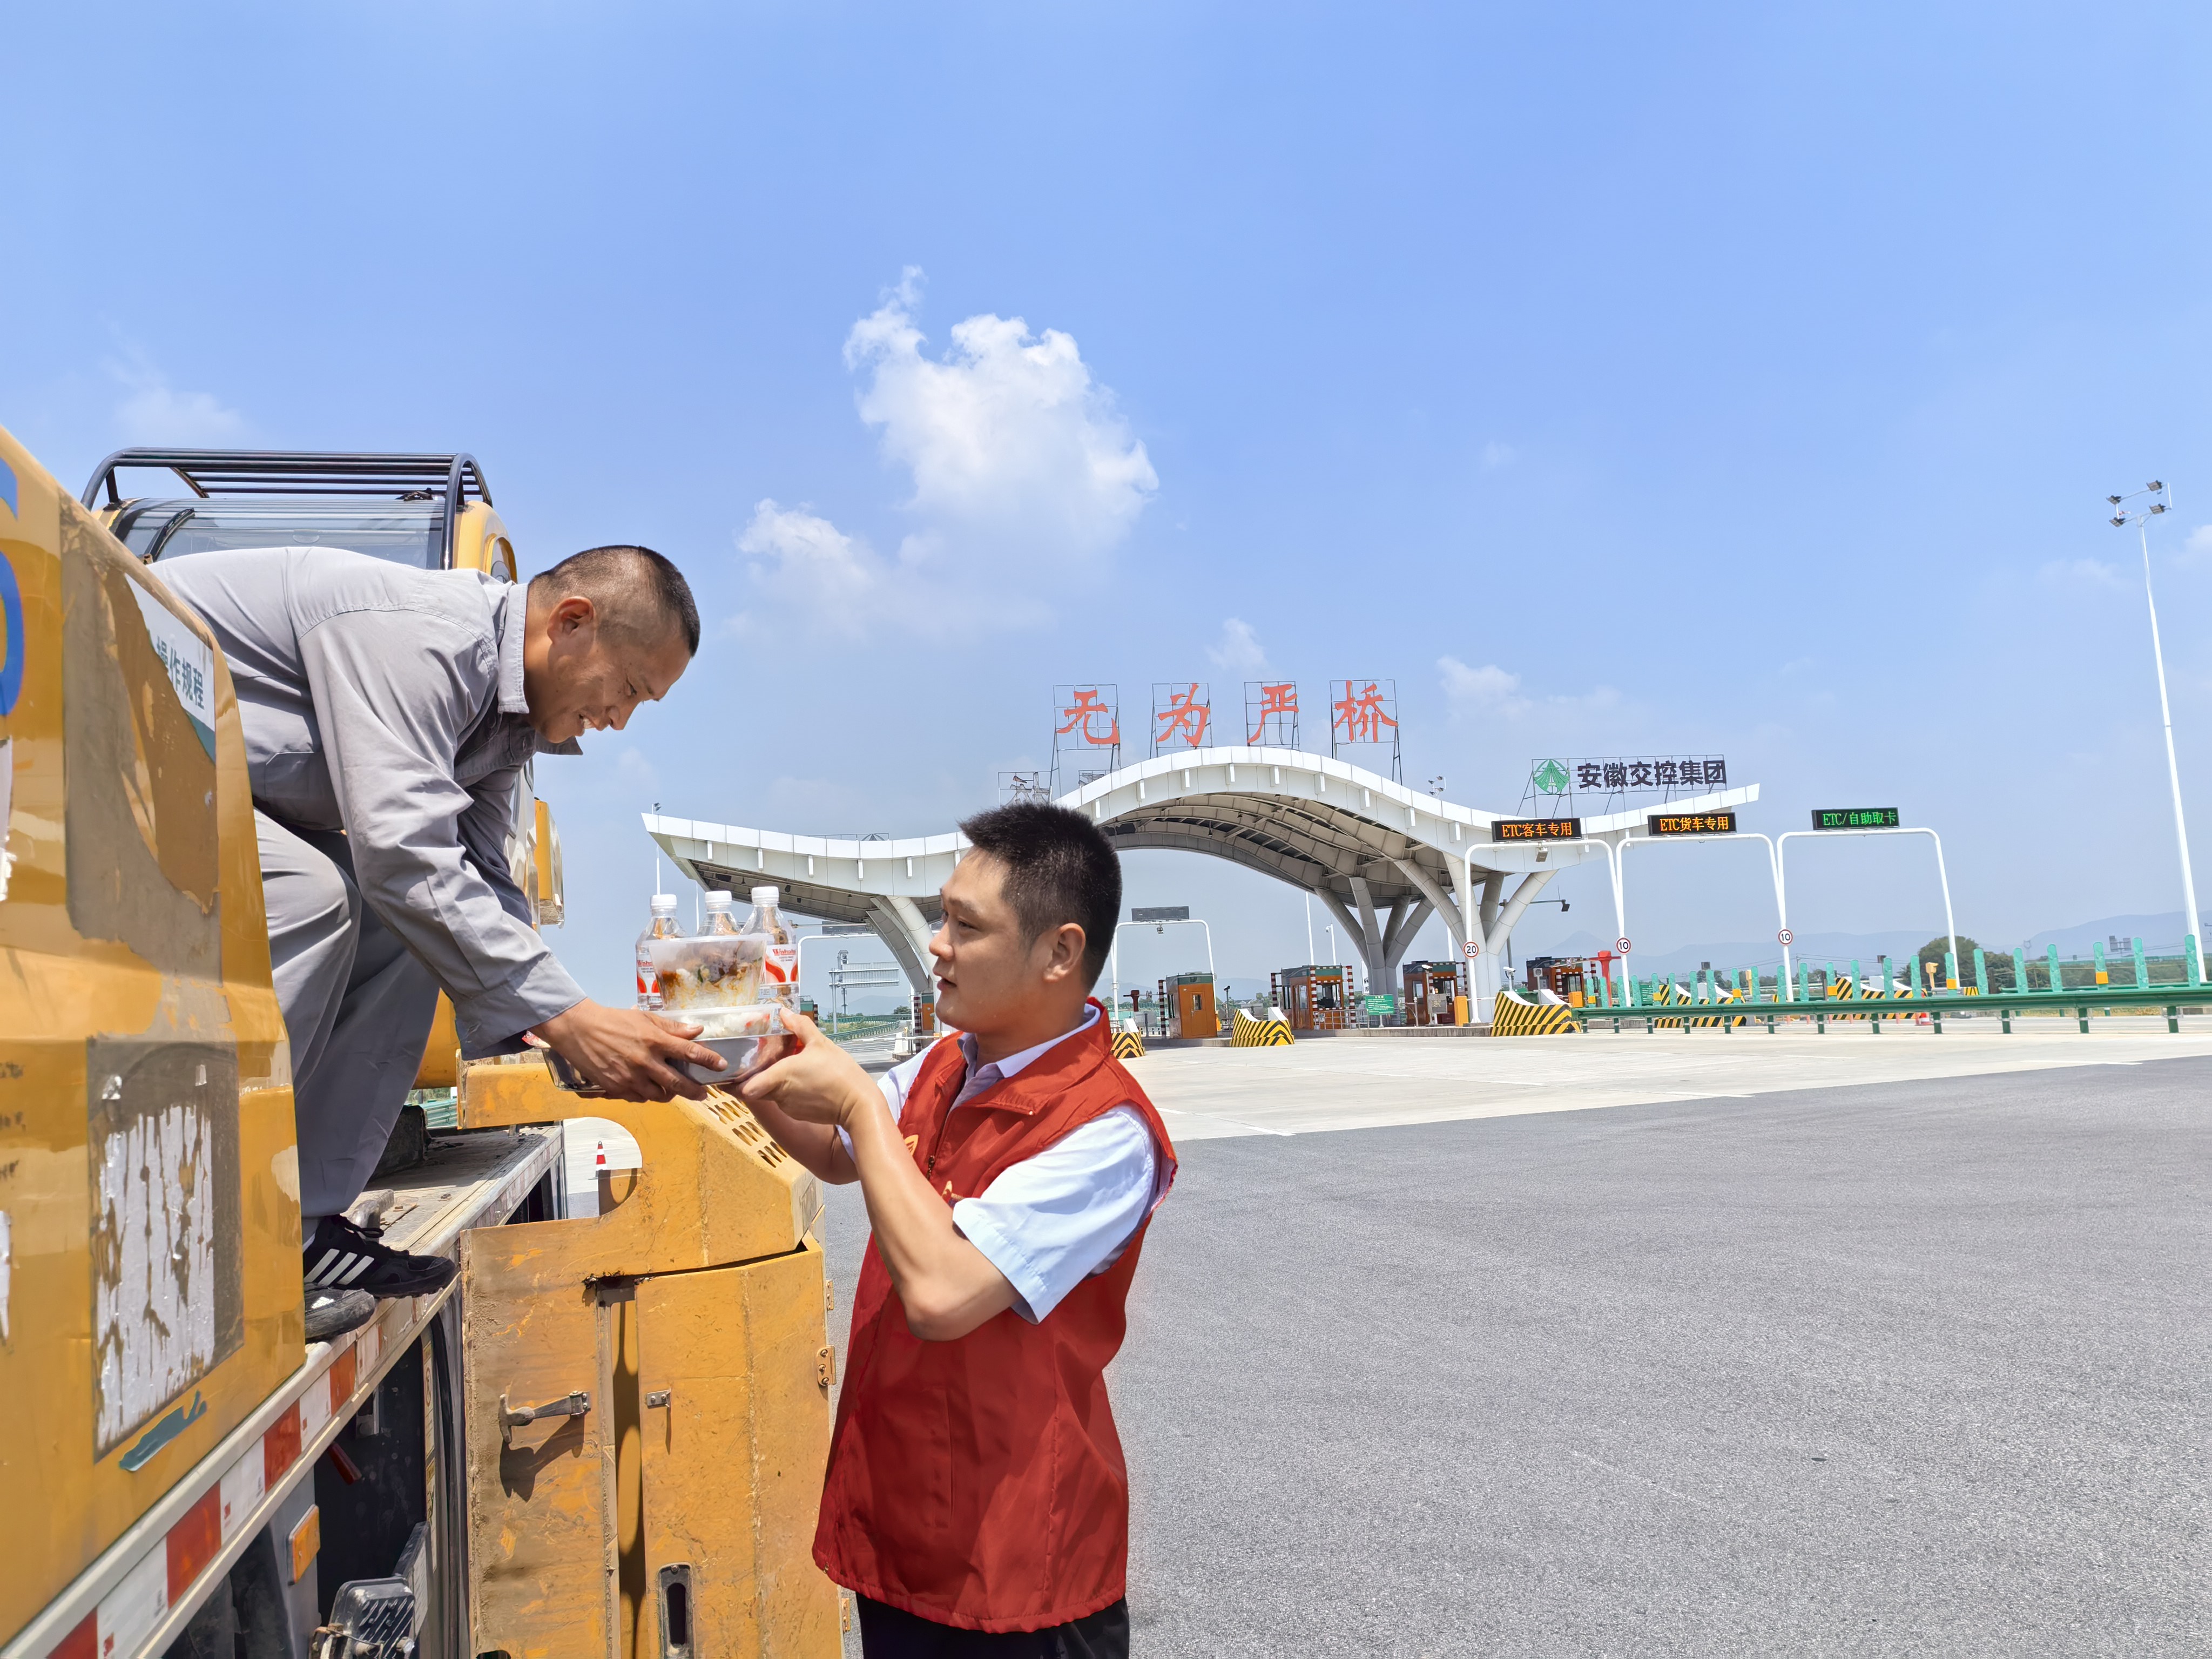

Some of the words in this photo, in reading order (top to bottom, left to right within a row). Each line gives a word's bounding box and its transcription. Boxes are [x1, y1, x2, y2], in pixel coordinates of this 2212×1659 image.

[1056, 680, 1399, 747] 无为严桥
[1577, 760, 1727, 789] 安徽交控集团
[1660, 816, 1729, 832] ETC货车专用
[1823, 811, 1897, 826] ETC/自助取卡
[1501, 821, 1572, 838] ETC客车专用
[1781, 933, 1791, 941] 10
[1467, 946, 1476, 954] 20
[1619, 941, 1629, 950] 10
